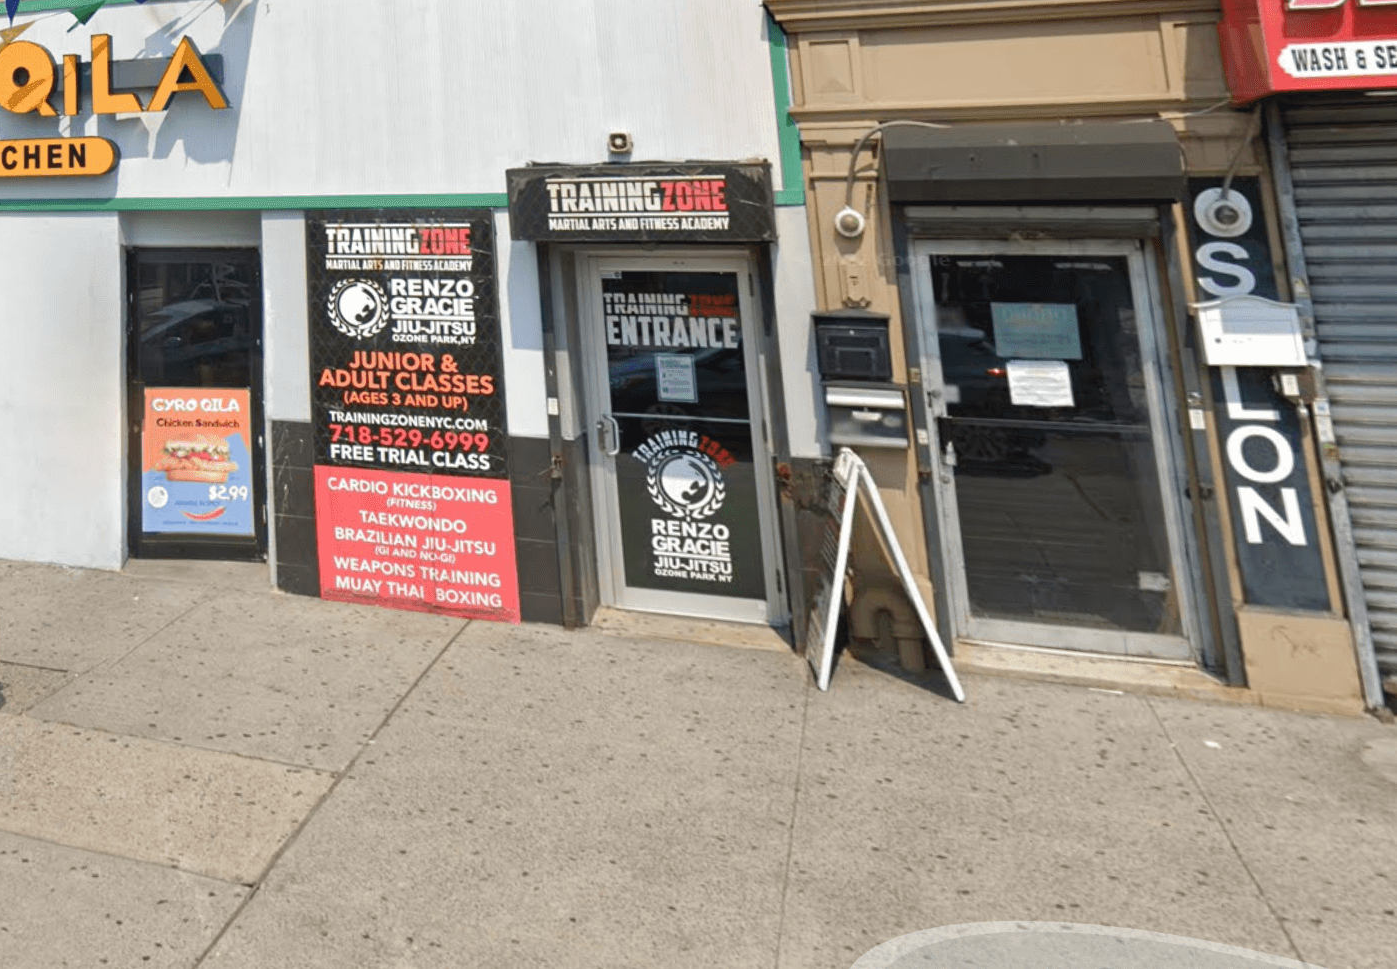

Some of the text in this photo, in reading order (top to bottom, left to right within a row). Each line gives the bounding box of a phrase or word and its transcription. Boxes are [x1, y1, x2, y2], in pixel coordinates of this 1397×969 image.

[1291, 47, 1348, 72] WASH
[549, 217, 729, 231] MARTIAL ARTS AND FITNESS ACADEMY
[326, 259, 472, 271] MARTIAL ARTS AND FITNESS ACADEMY
[391, 279, 474, 297] RENZO
[391, 298, 474, 315] GRACIE
[392, 320, 476, 335] JIU-JITSU
[606, 315, 739, 349] ENTRANCE
[392, 334, 428, 343] OZONE
[350, 351, 459, 373] JUNIOR &
[319, 369, 494, 395] ADULT CLASSES
[152, 398, 240, 413] GYRO QILA
[344, 391, 468, 411] (AGES 3 AND UP)
[156, 418, 240, 429] Chicken Sandwich
[329, 411, 487, 431] TRAININGZONENYC.COM
[329, 424, 489, 452] 718-529-6999
[330, 444, 490, 470] FREE TRIAL CLASS
[327, 477, 497, 504] CARDIO KICKBOXING
[360, 510, 467, 533] TAEKWONDO
[651, 519, 730, 540] RENZO
[335, 527, 496, 556] BRAZILIAN JIU-JITSU
[652, 536, 730, 557] GRACIE
[392, 548, 416, 559] AND
[334, 556, 501, 588] WEAPONS TRAINING
[654, 556, 732, 574] JIU-JITSU
[654, 568, 733, 583] OZONE PARK NY
[336, 576, 502, 608] MUAY THAI BOXING
